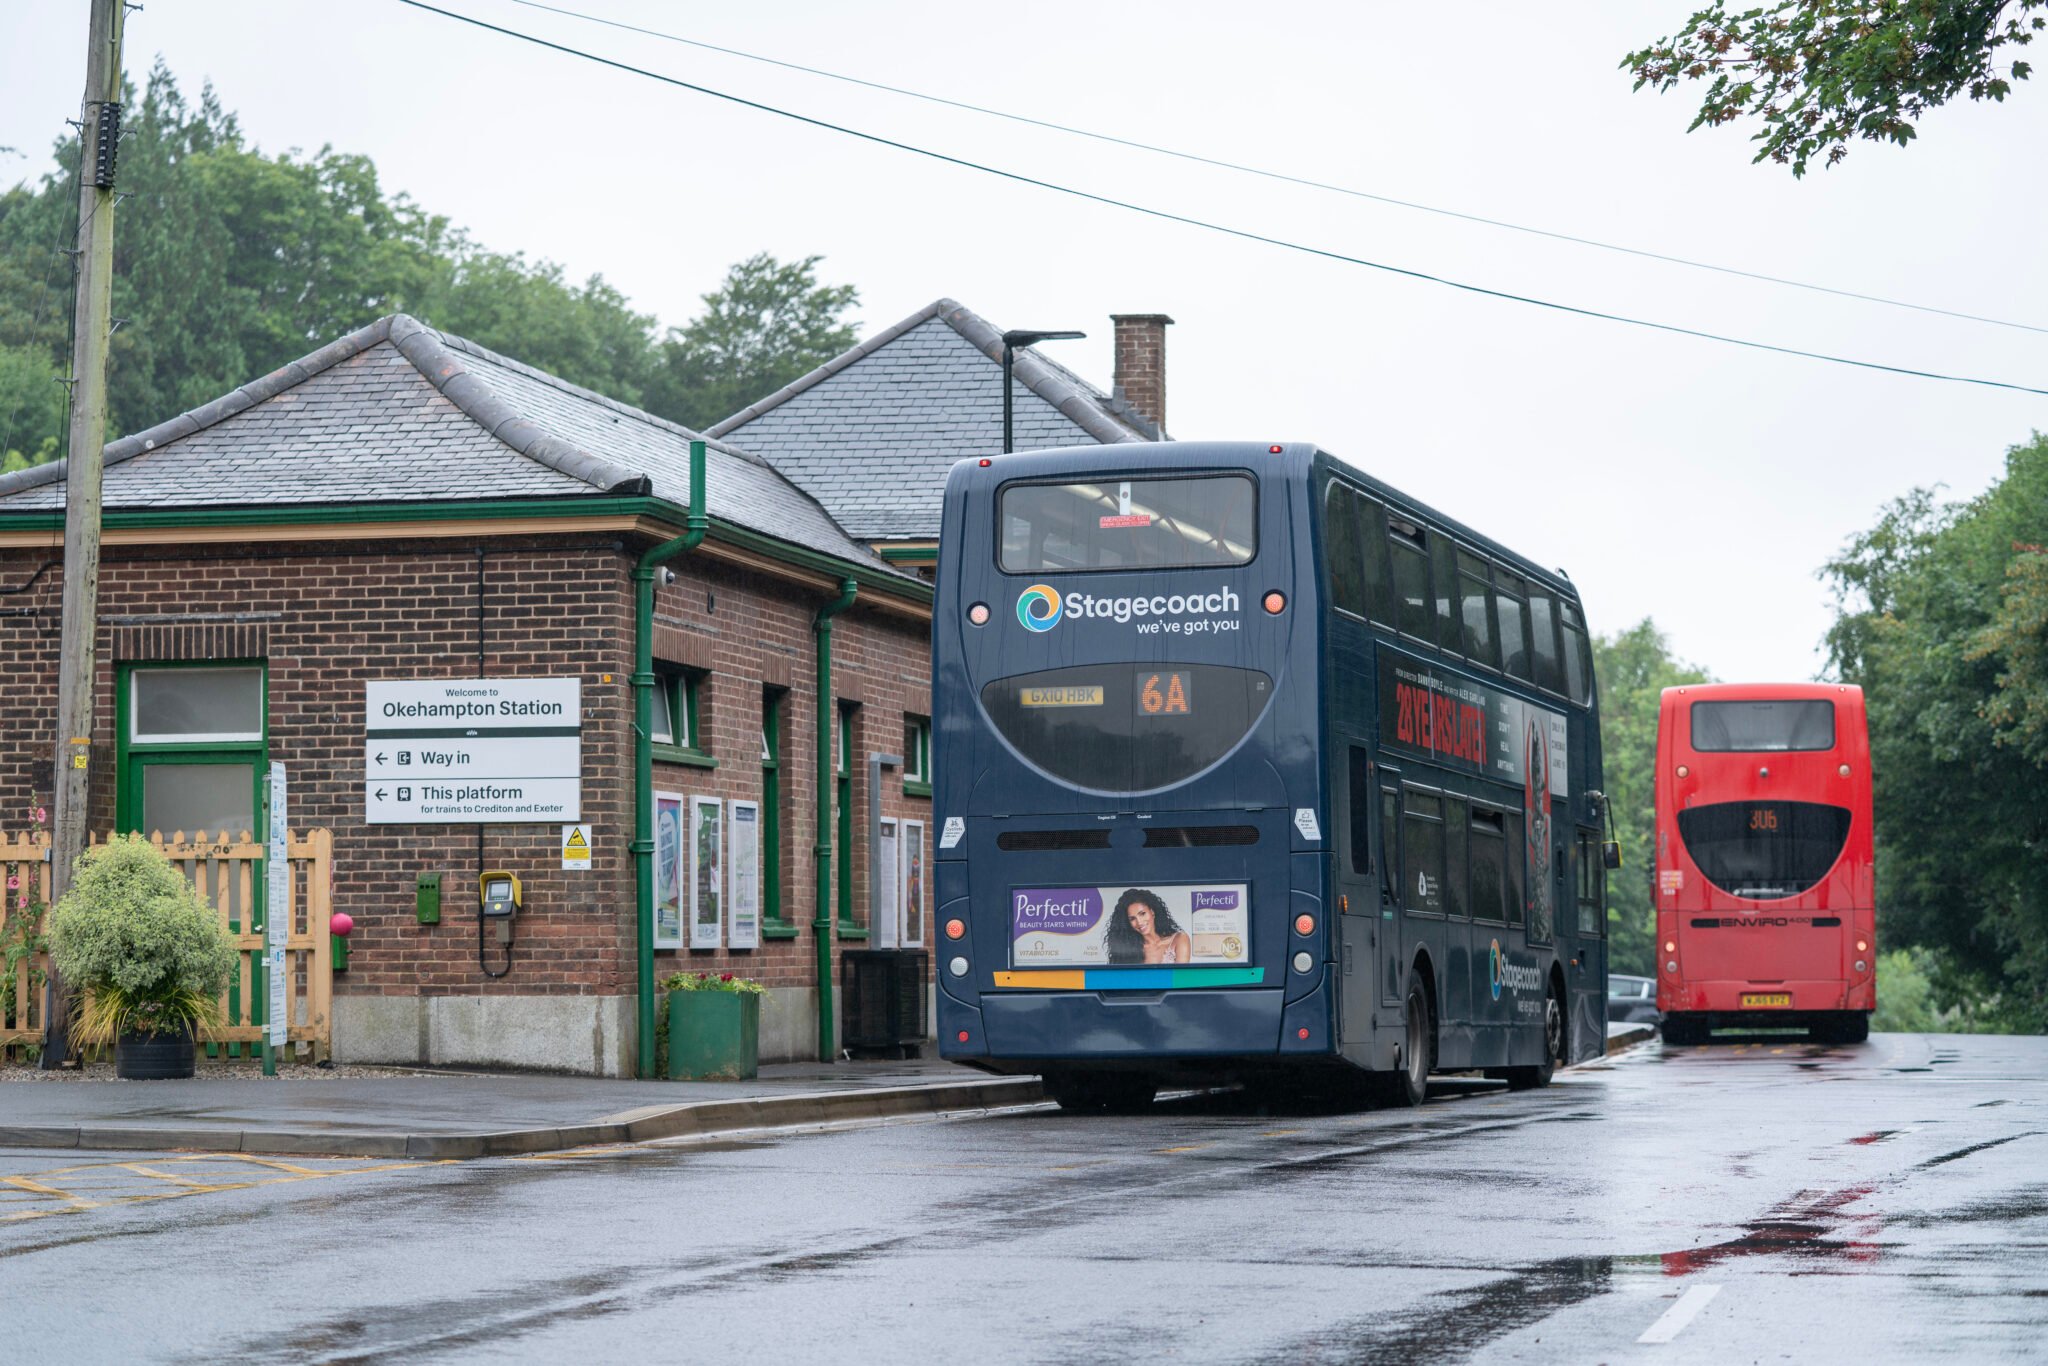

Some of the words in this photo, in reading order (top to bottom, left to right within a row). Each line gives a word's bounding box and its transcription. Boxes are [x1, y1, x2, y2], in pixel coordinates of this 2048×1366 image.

[1064, 586, 1239, 623] Stagecoach
[1137, 620, 1180, 634] we've
[1184, 619, 1210, 635] got
[1213, 620, 1240, 634] you
[445, 688, 488, 697] Welcome
[490, 688, 498, 696] to
[1032, 688, 1064, 702] GX10
[1066, 688, 1096, 702] HBK
[1142, 672, 1188, 712] 6A
[383, 702, 495, 720] Okehampton
[500, 700, 562, 716] Station
[1396, 682, 1413, 744] 28
[1412, 686, 1452, 756] YEARS
[1452, 700, 1487, 766] LATER
[421, 751, 454, 767] Way
[457, 750, 470, 764] in
[421, 786, 452, 800] This
[456, 786, 522, 802] platform
[421, 805, 434, 814] for
[436, 805, 461, 813] trains
[474, 804, 514, 813] Crediton
[515, 804, 532, 813] and
[534, 804, 564, 812] Exeter
[1016, 894, 1089, 923] Perfectil
[1195, 893, 1234, 908] Perfectil
[1721, 917, 1788, 927] ENVIRO
[1502, 954, 1540, 996] Stagecoach
